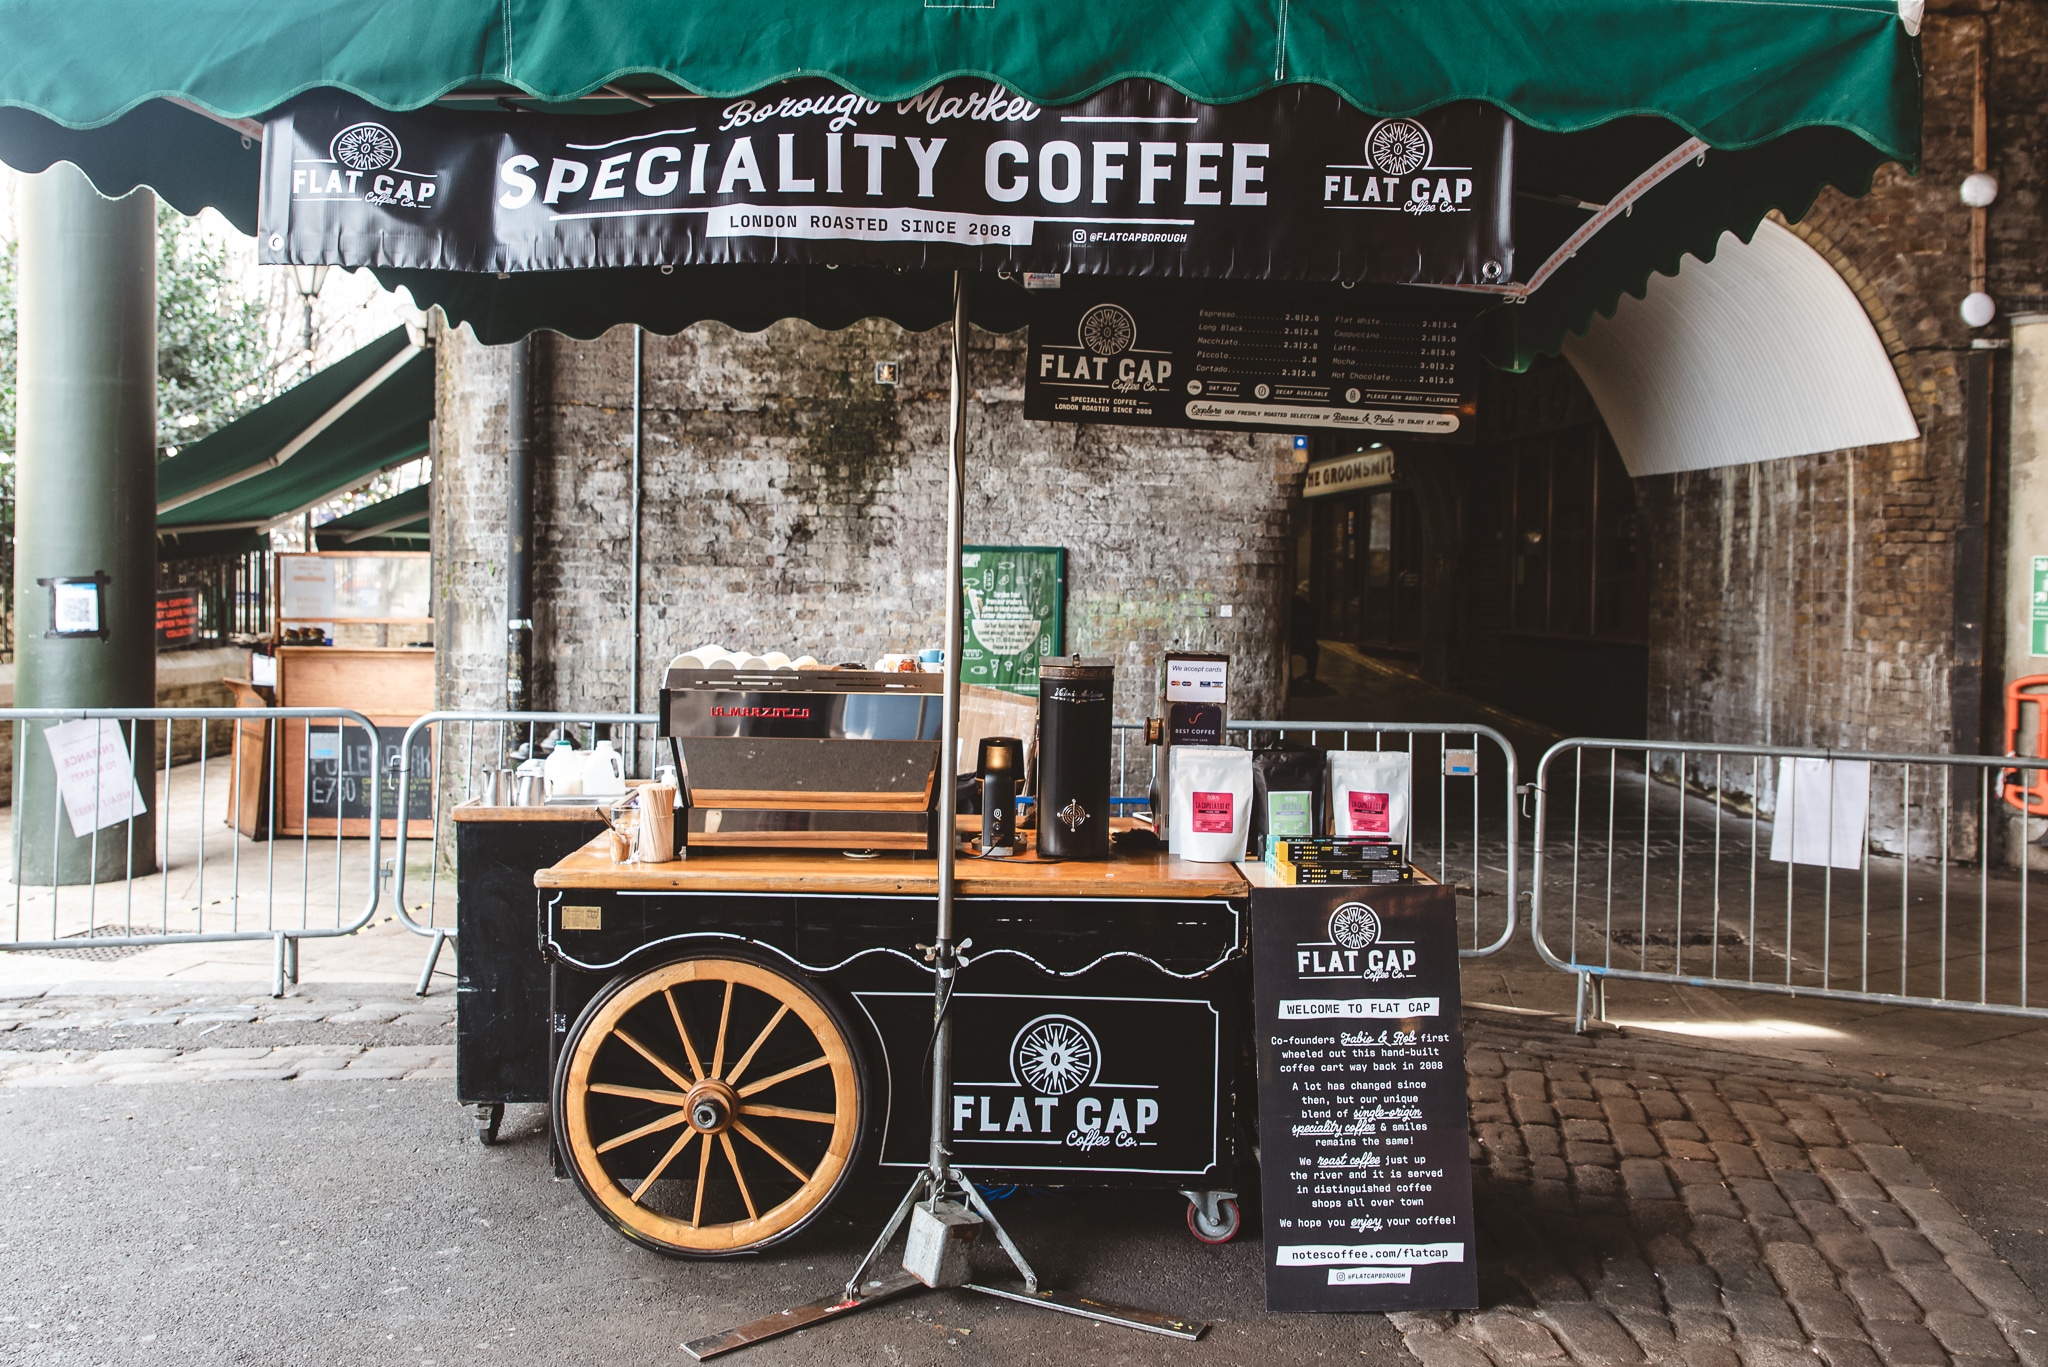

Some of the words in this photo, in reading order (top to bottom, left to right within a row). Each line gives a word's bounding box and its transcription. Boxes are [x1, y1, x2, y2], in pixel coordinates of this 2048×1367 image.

[719, 93, 881, 132] Borough
[499, 132, 948, 210] SPECIALITY
[985, 140, 1270, 206] COFFEE
[293, 170, 363, 194] FLAT
[373, 175, 436, 202] CAP
[1324, 176, 1400, 203] FLAT
[1410, 178, 1472, 204] CAP
[365, 191, 397, 206] Coffee
[400, 198, 416, 208] Co.
[1403, 200, 1436, 216] Coffee
[1439, 201, 1456, 212] Co.
[730, 215, 797, 228] LONDON
[810, 216, 888, 231] ROASTED
[901, 220, 956, 234] SINCE
[969, 223, 1011, 238] 2008
[1090, 232, 1187, 243] @FLATCAPBOROUGH
[1040, 354, 1108, 380] FLAT
[1119, 359, 1172, 383] CAP
[1112, 378, 1139, 394] Coffee
[1143, 380, 1157, 392] Co.
[1071, 396, 1110, 404] SPECIALITY
[1191, 405, 1221, 416] Explore
[1333, 413, 1358, 422] Beans
[1362, 413, 1372, 425] &
[1374, 415, 1394, 424] Pods
[1308, 471, 1320, 487] HE
[1297, 951, 1358, 972] FLAT
[1368, 950, 1416, 971] CAP
[1363, 969, 1389, 982] Coffee
[1392, 969, 1405, 979] Co.
[1287, 1004, 1340, 1014] WELCOME
[1348, 1004, 1362, 1013] TO
[1371, 1003, 1400, 1013] FLAT
[1409, 1003, 1430, 1012] CAP
[1271, 1036, 1335, 1045] Co-founders
[1341, 1031, 1374, 1044] Fabio
[1378, 1030, 1391, 1046] &
[1393, 1031, 1417, 1044] Rob
[1421, 1034, 1449, 1042] first
[1282, 1050, 1323, 1058] wheeled
[1352, 1049, 1375, 1057] this
[1381, 1048, 1439, 1057] hand-built
[1280, 1064, 1315, 1072] coffee
[1321, 1063, 1344, 1072] cart
[1349, 1064, 1367, 1072] way
[1373, 1062, 1396, 1071] back
[1403, 1062, 1414, 1070] in
[1420, 1062, 1443, 1070] 2008
[1292, 1082, 1298, 1091] A
[1305, 1082, 1321, 1090] lot
[1328, 1082, 1345, 1090] has
[1351, 1081, 1391, 1091] changed
[1398, 1080, 1427, 1089] since
[1302, 1096, 1330, 1105] then,
[1337, 1096, 1354, 1104] but
[1384, 1095, 1418, 1104] unique
[953, 1096, 1059, 1132] FLAT
[1076, 1097, 1159, 1134] CAP
[1302, 1109, 1331, 1119] blend
[1337, 1109, 1349, 1117] of
[1353, 1105, 1422, 1122] single-origin
[1292, 1120, 1342, 1138] speciality
[1343, 1120, 1376, 1136] coffee
[1381, 1123, 1386, 1131] &
[1392, 1123, 1427, 1131] smiles
[1066, 1129, 1111, 1152] Coffee
[1115, 1130, 1137, 1147] Co.
[1316, 1138, 1356, 1147] remains
[1363, 1137, 1379, 1146] the
[1386, 1137, 1414, 1145] same!
[1299, 1158, 1311, 1166] We
[1318, 1154, 1347, 1167] roast
[1350, 1152, 1381, 1169] coffee
[1385, 1156, 1408, 1166] just
[1414, 1156, 1426, 1165] up
[1290, 1172, 1307, 1180] the
[1314, 1171, 1343, 1179] river
[1349, 1170, 1367, 1179] and
[1373, 1170, 1384, 1178] it
[1391, 1170, 1402, 1178] is
[1408, 1169, 1443, 1178] served
[1297, 1185, 1308, 1194] in
[1314, 1184, 1391, 1194] distinguished
[1397, 1184, 1432, 1193] coffee
[1312, 1199, 1341, 1209] shops
[1347, 1198, 1364, 1207] all
[1400, 1198, 1424, 1206] town
[1280, 1219, 1292, 1228] We
[1298, 1219, 1322, 1229] hope
[1328, 1219, 1345, 1228] you
[1350, 1214, 1383, 1233] enjoy
[1387, 1217, 1410, 1226] your
[1416, 1216, 1456, 1225] coffee!
[1293, 1248, 1448, 1260] notescoffee.com/flatcap
[1348, 1272, 1405, 1280] @FLATCAPBOROUGH
